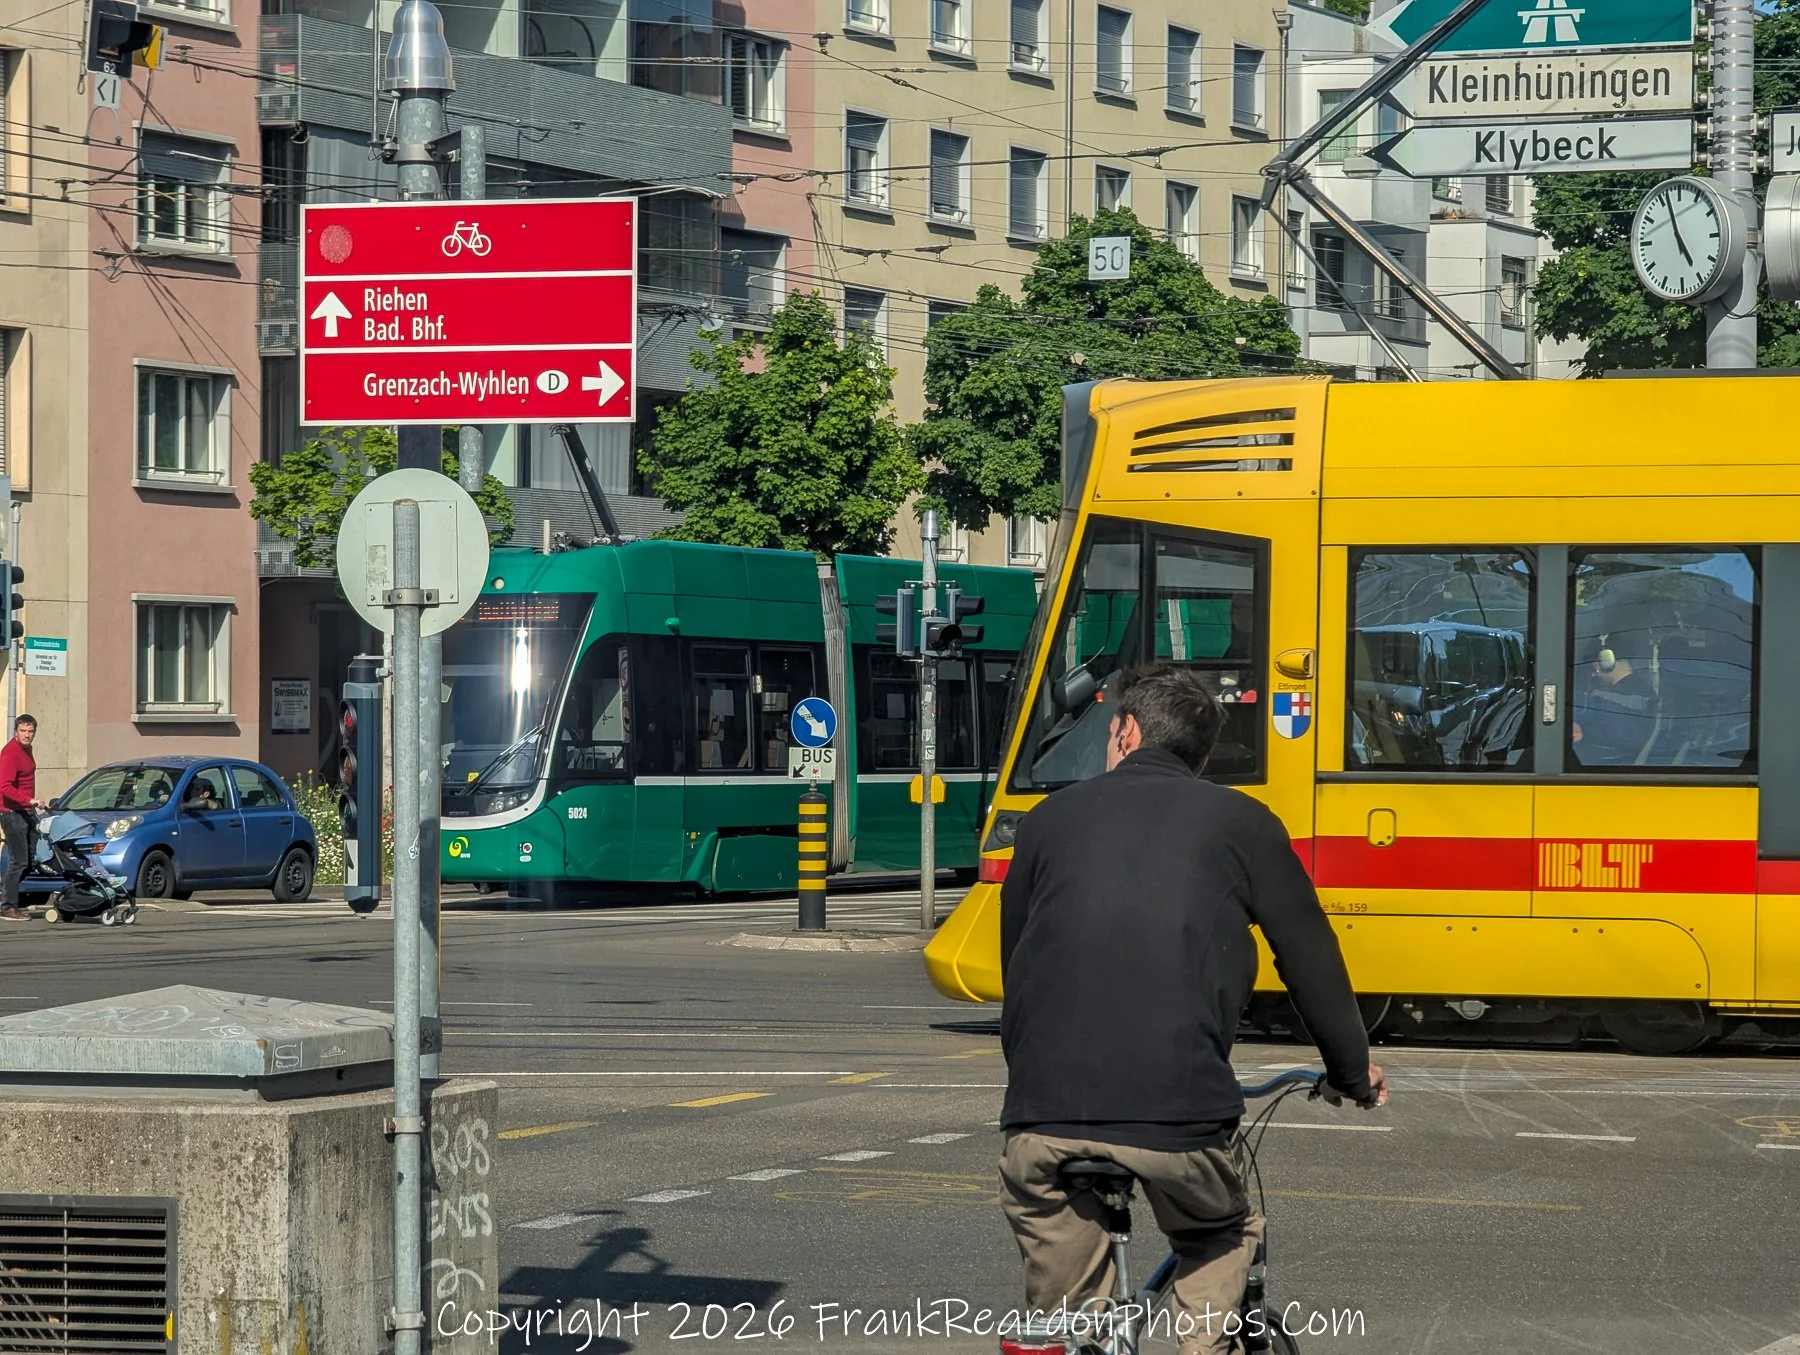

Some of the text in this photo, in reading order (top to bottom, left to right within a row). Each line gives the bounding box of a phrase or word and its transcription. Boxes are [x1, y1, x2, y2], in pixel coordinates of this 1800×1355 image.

[103, 61, 117, 75] 62
[1428, 62, 1670, 109] Kleinhüningen
[1475, 126, 1618, 171] Klybeck
[1786, 125, 1800, 156] J
[1094, 245, 1124, 271] 50
[363, 286, 428, 312] Riehen
[363, 314, 448, 341] Bad. Bhf.
[363, 369, 561, 402] Grenzach-Wyhlen D
[801, 748, 833, 764] BUS
[567, 806, 588, 819] 5024
[1538, 842, 1654, 889] BLT
[1347, 902, 1368, 912] 159
